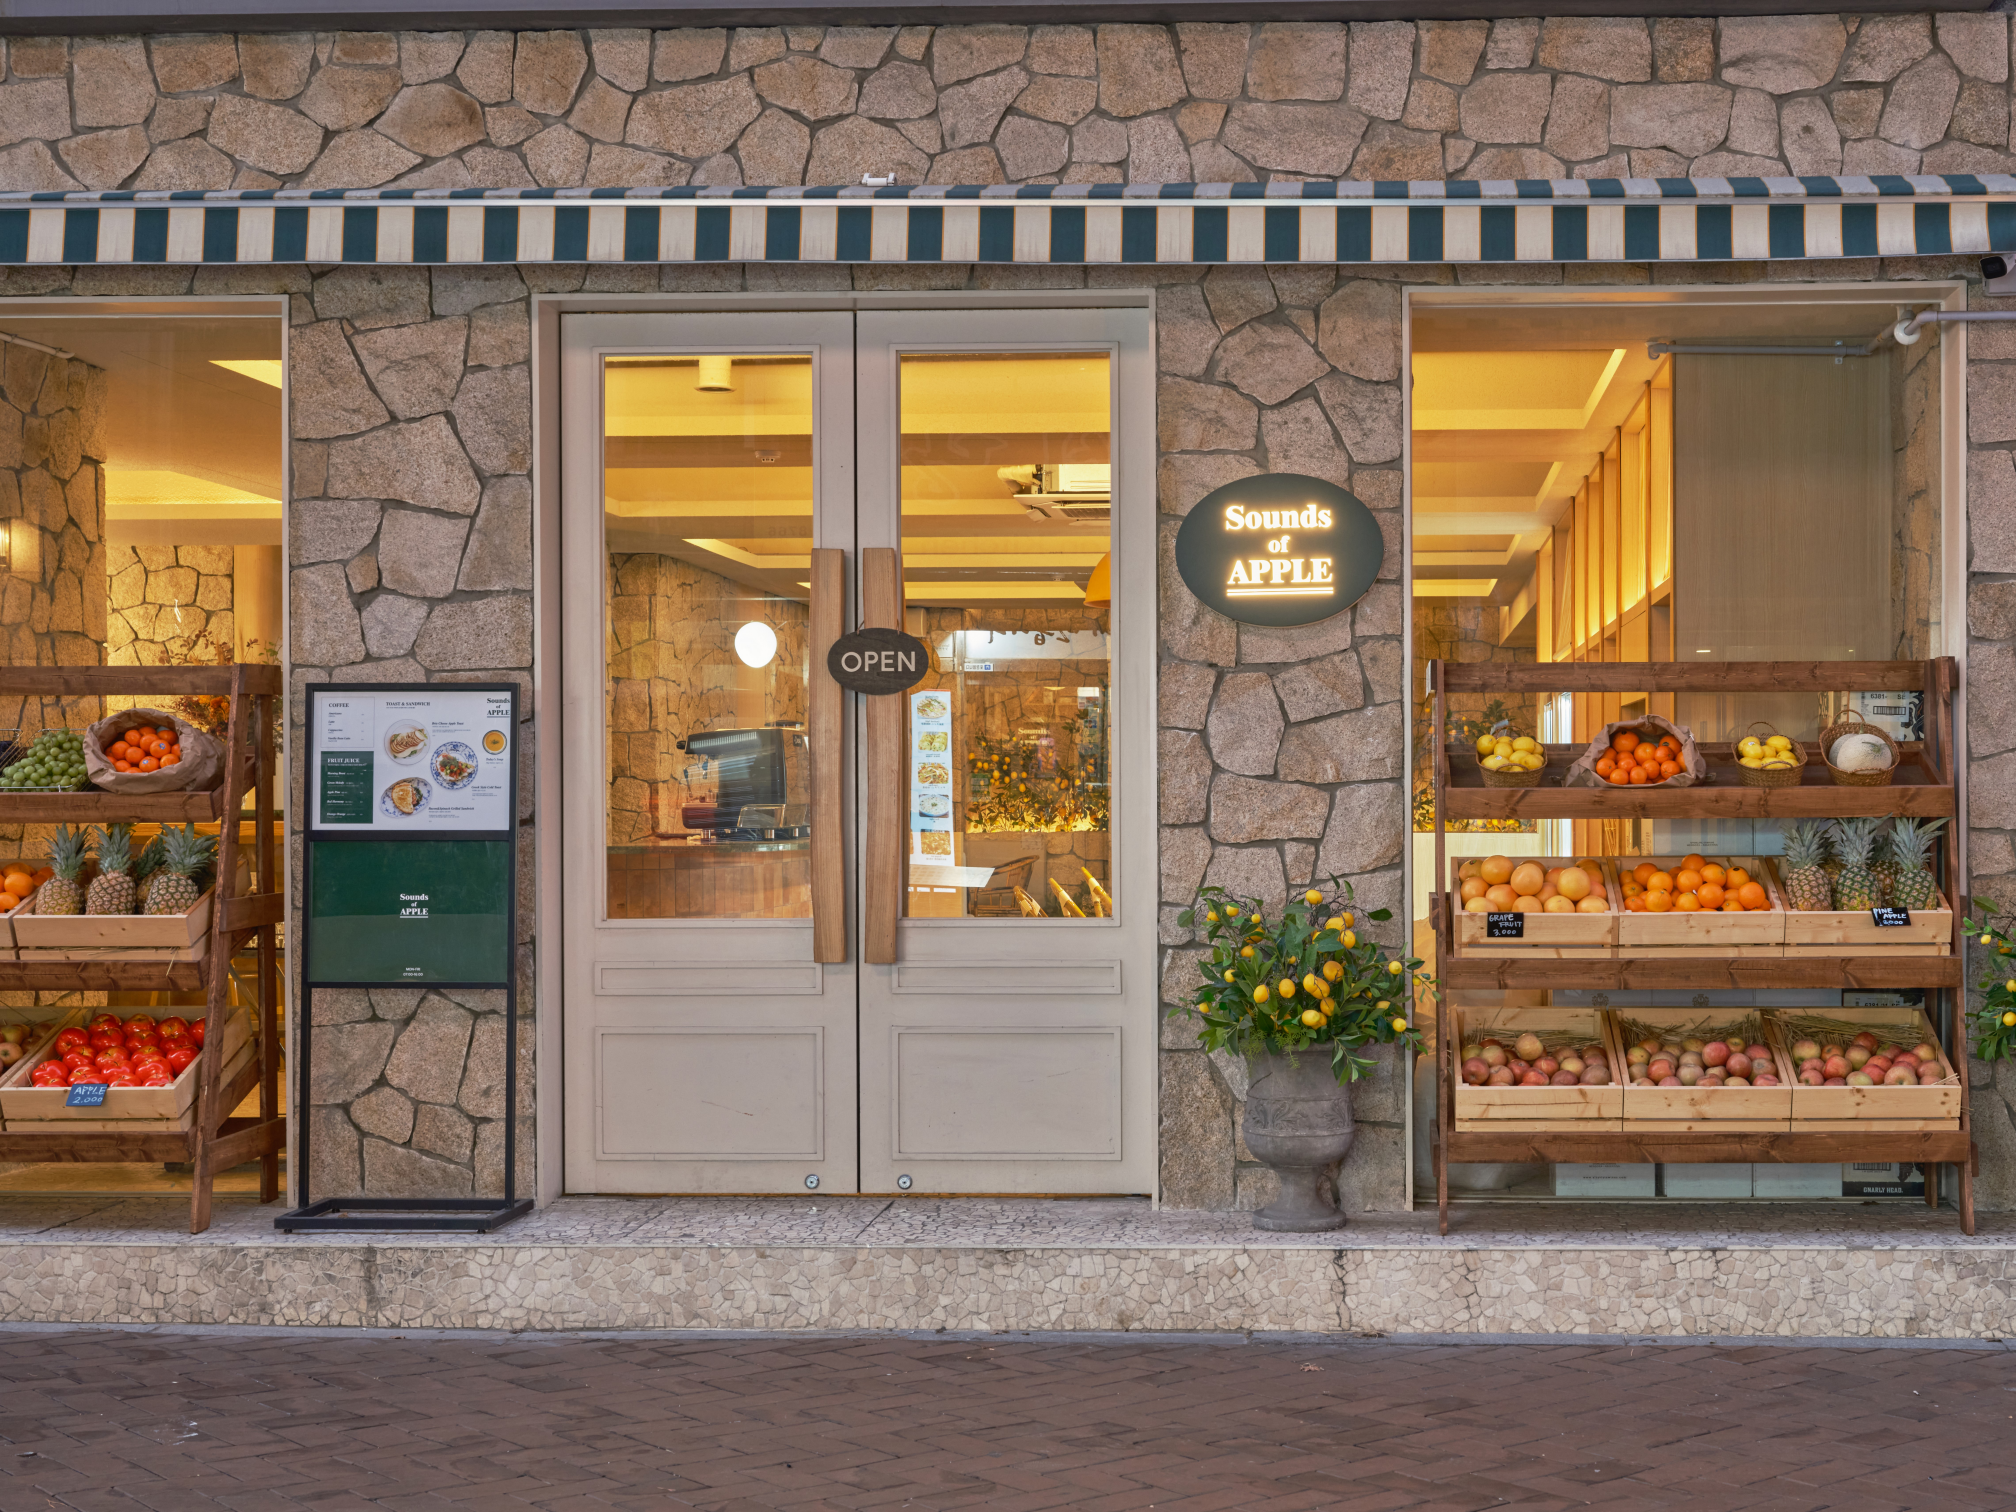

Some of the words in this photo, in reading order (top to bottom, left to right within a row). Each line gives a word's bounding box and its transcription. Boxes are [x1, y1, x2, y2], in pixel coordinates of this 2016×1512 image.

[1226, 504, 1332, 530] Sounds
[1268, 535, 1290, 552] of
[1227, 558, 1332, 584] APPLE
[841, 651, 916, 672] OPEN
[1489, 914, 1514, 922] GRAPE
[74, 1086, 107, 1095] APPLE
